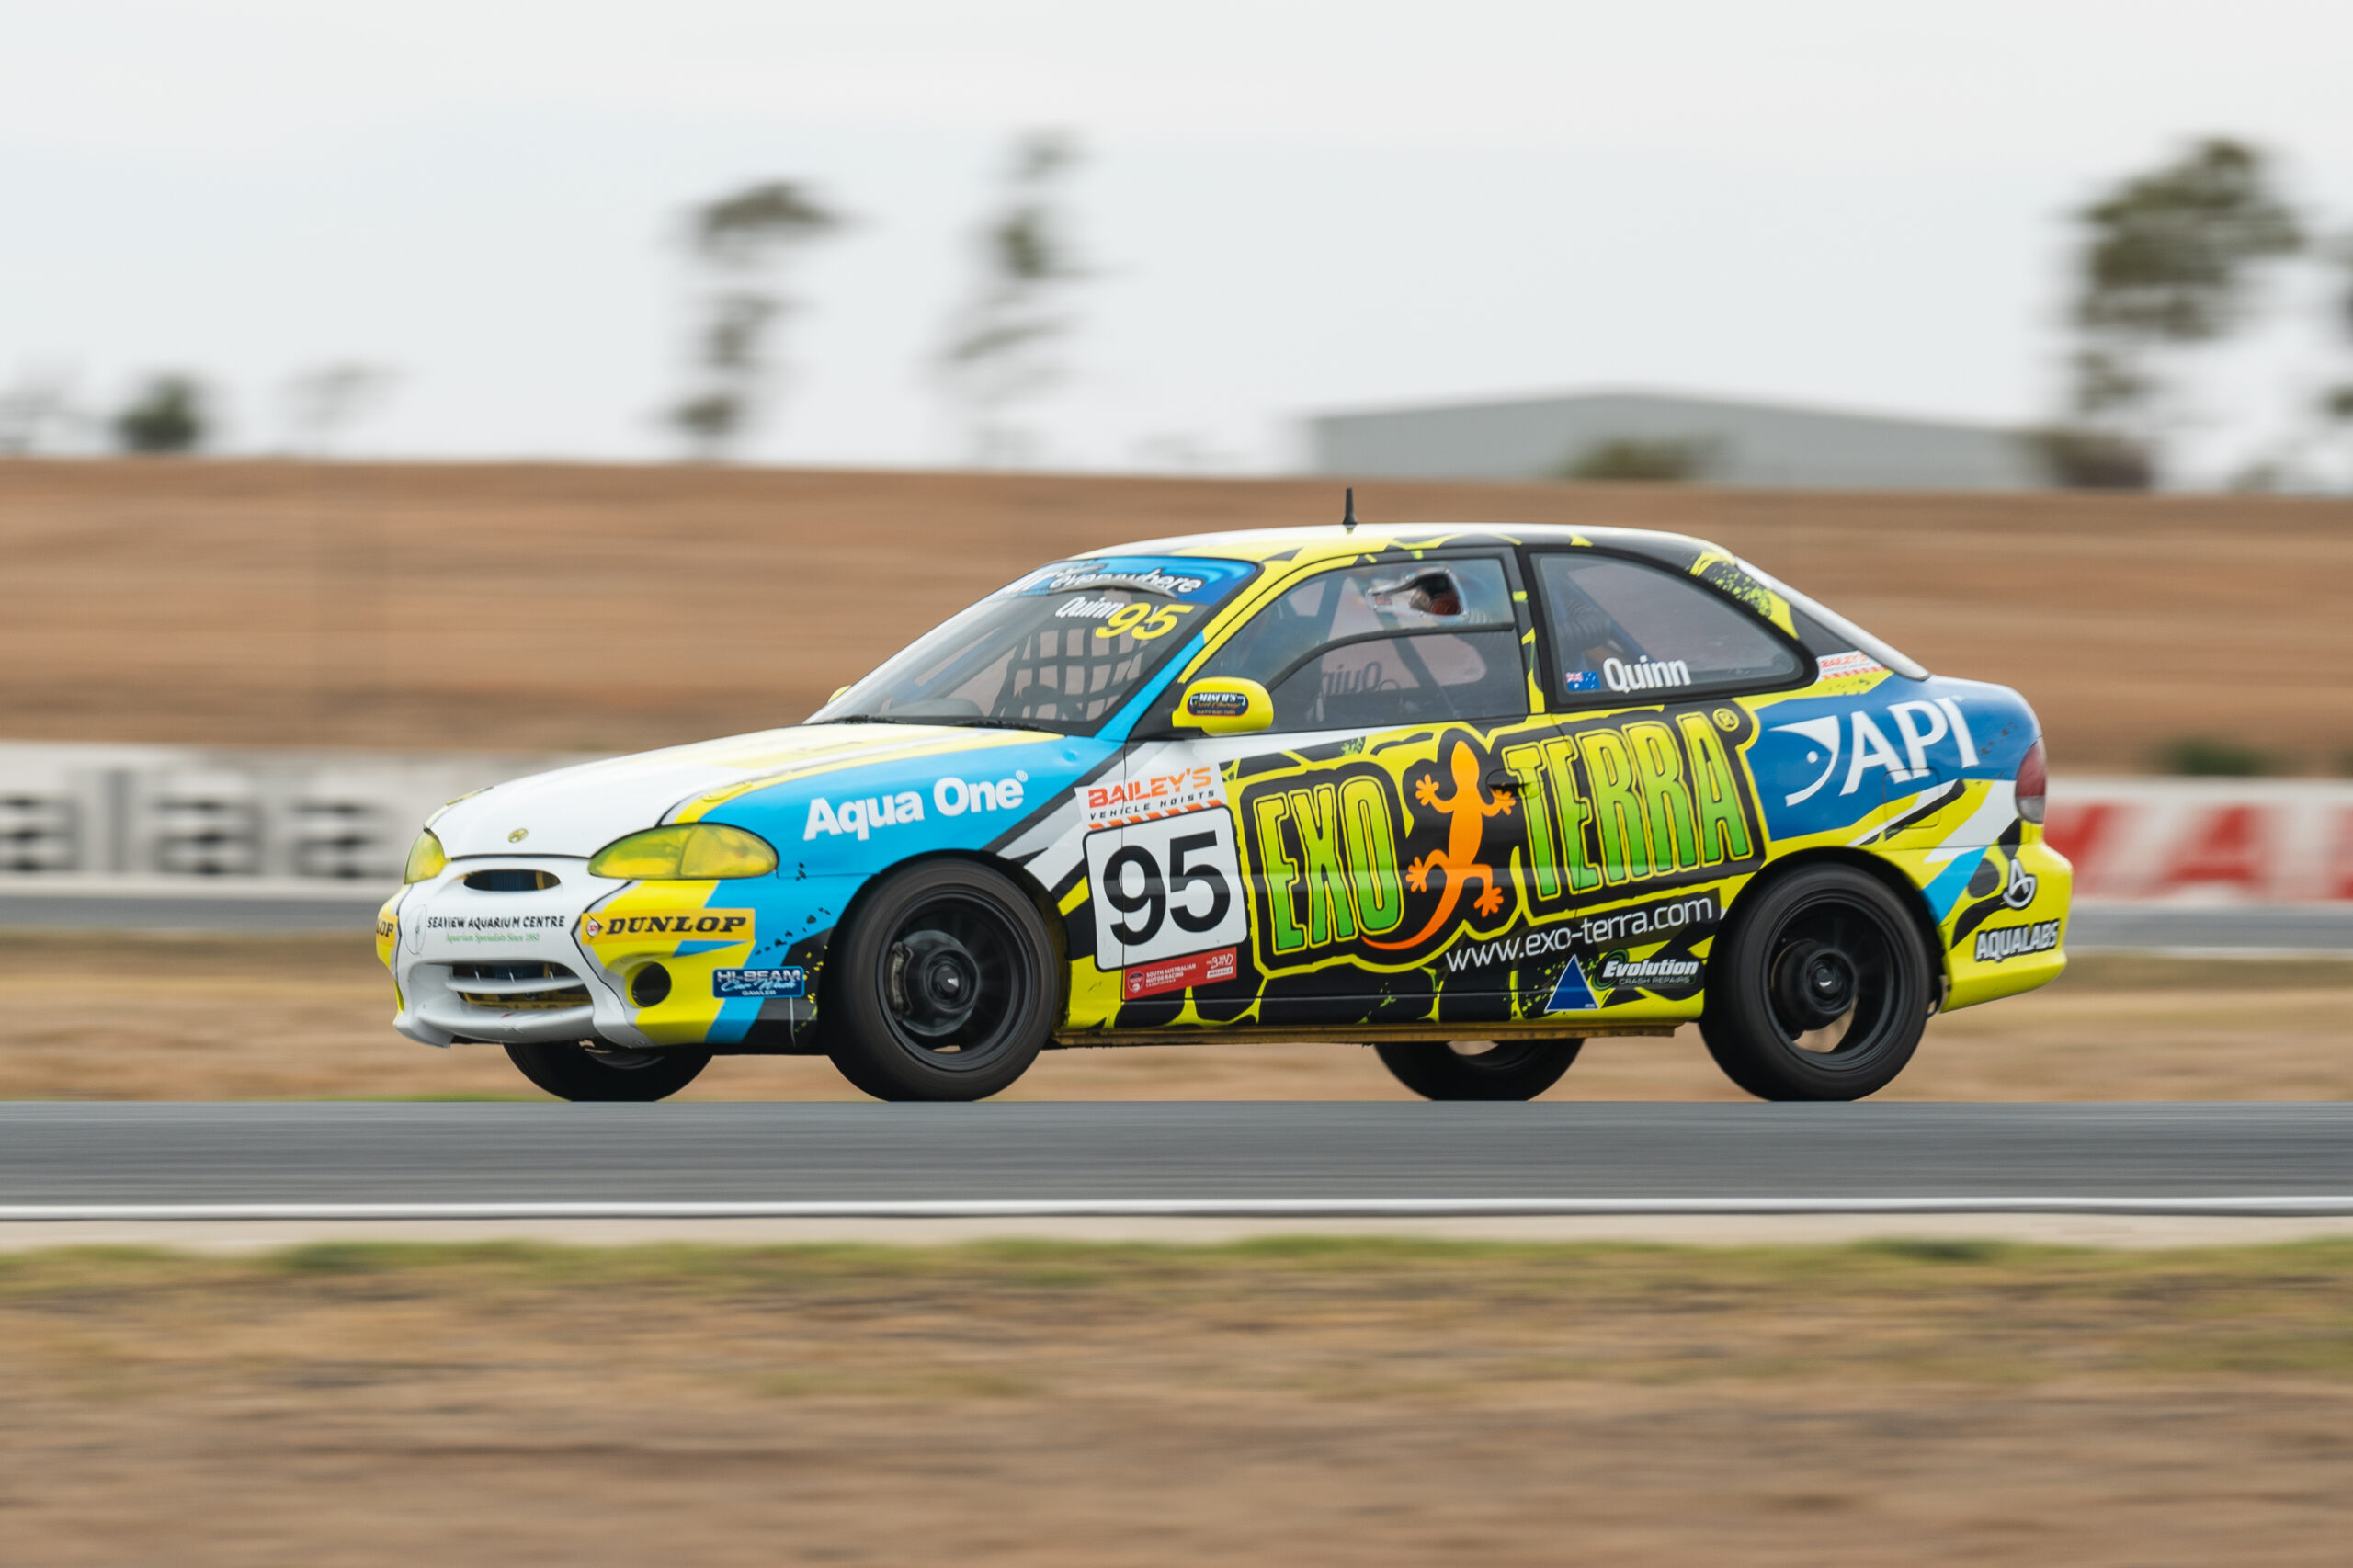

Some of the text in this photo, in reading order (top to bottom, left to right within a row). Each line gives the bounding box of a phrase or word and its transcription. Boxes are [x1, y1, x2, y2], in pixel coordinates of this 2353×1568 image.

[1055, 596, 1194, 640] Quinn 95
[1603, 654, 1691, 695] Quinn
[1838, 697, 1980, 797] API
[1088, 767, 1212, 809] BAILEY'S
[1089, 790, 1215, 821] VEHICLE HOISTS
[1502, 711, 1754, 902] TERRA
[803, 777, 1025, 841] Aqua One
[1253, 775, 1404, 956] EXO
[1103, 830, 1231, 946] 95
[427, 915, 565, 930] SEAVIEW AQUARIUM CENTRE
[606, 916, 746, 935] DUNLOP
[1445, 896, 1713, 973] www.exo-terra.com
[1975, 920, 2060, 961] AQUALABS
[717, 969, 801, 983] HI-BEAM
[1601, 958, 1699, 979] Evolution
[1619, 975, 1692, 986] CRASH REPAIRS
